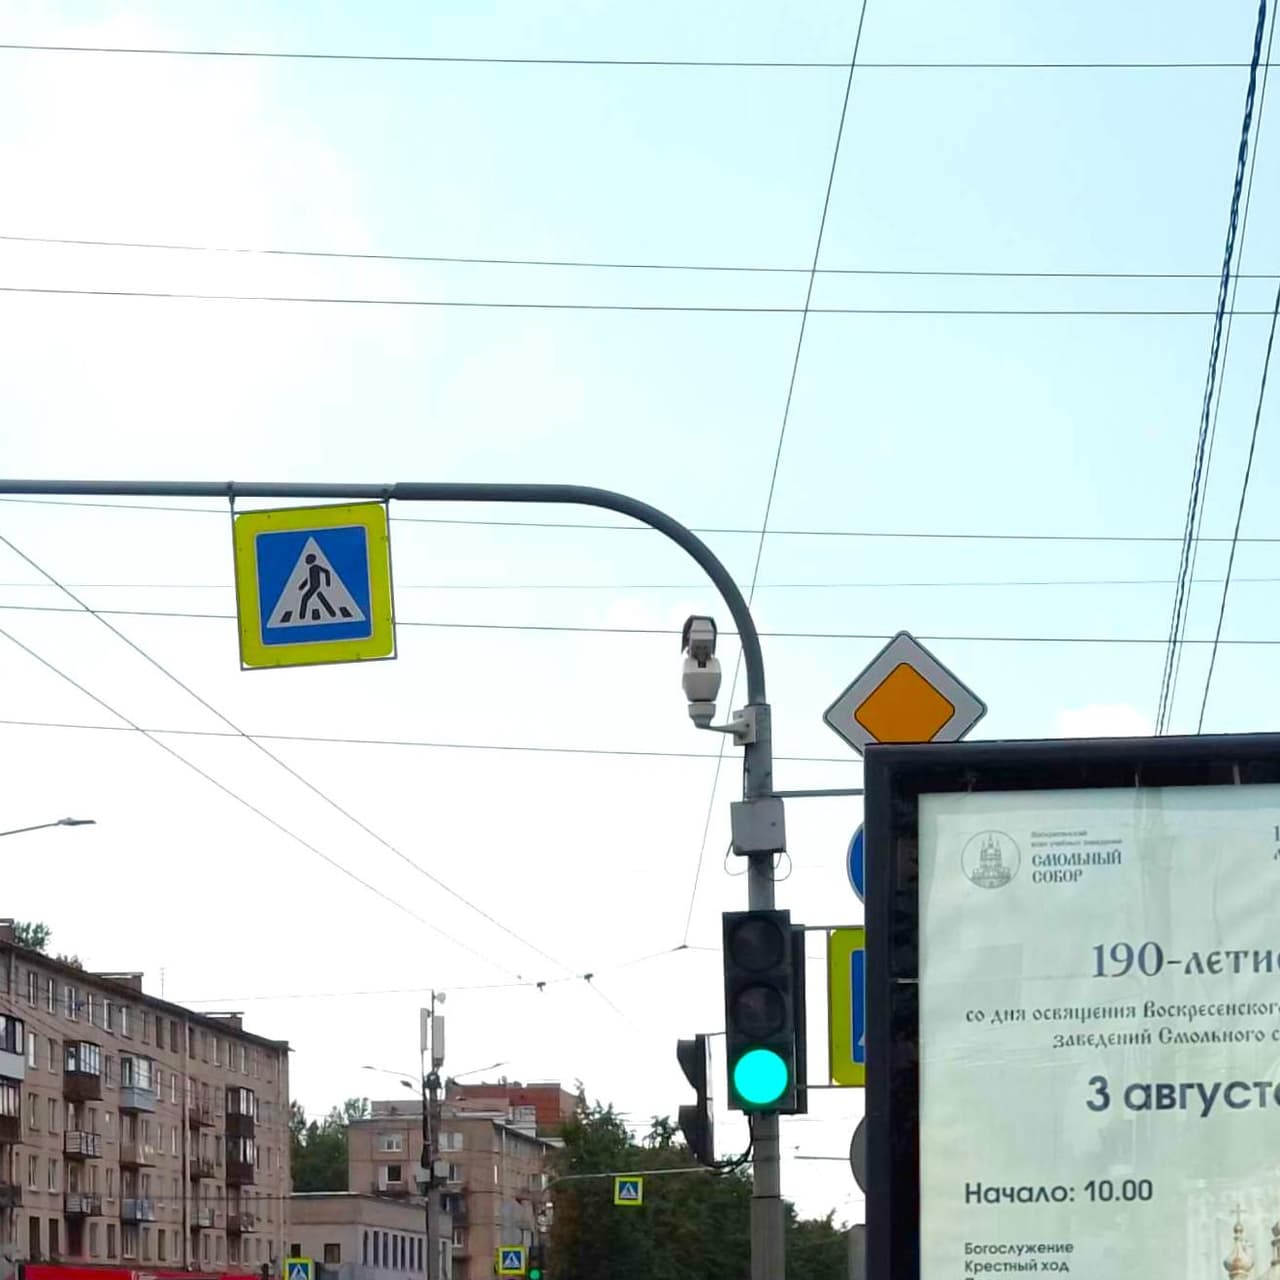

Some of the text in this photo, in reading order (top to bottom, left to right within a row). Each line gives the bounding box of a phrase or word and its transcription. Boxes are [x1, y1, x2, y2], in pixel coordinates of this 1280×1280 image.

[1031, 848, 1122, 868] СМОЛЬНЫЙ
[1032, 868, 1083, 884] СОБОР
[966, 1008, 985, 1022] со
[991, 1008, 1026, 1024] дня
[1032, 1005, 1136, 1023] освящения
[1053, 1028, 1152, 1049] заведений
[1158, 1026, 1266, 1044] Смольного
[1086, 1075, 1111, 1112] 3
[965, 1179, 1153, 1204] Начало: 10.00
[964, 1242, 1074, 1256] Богослужение
[964, 1259, 1070, 1275] Крестный ход
